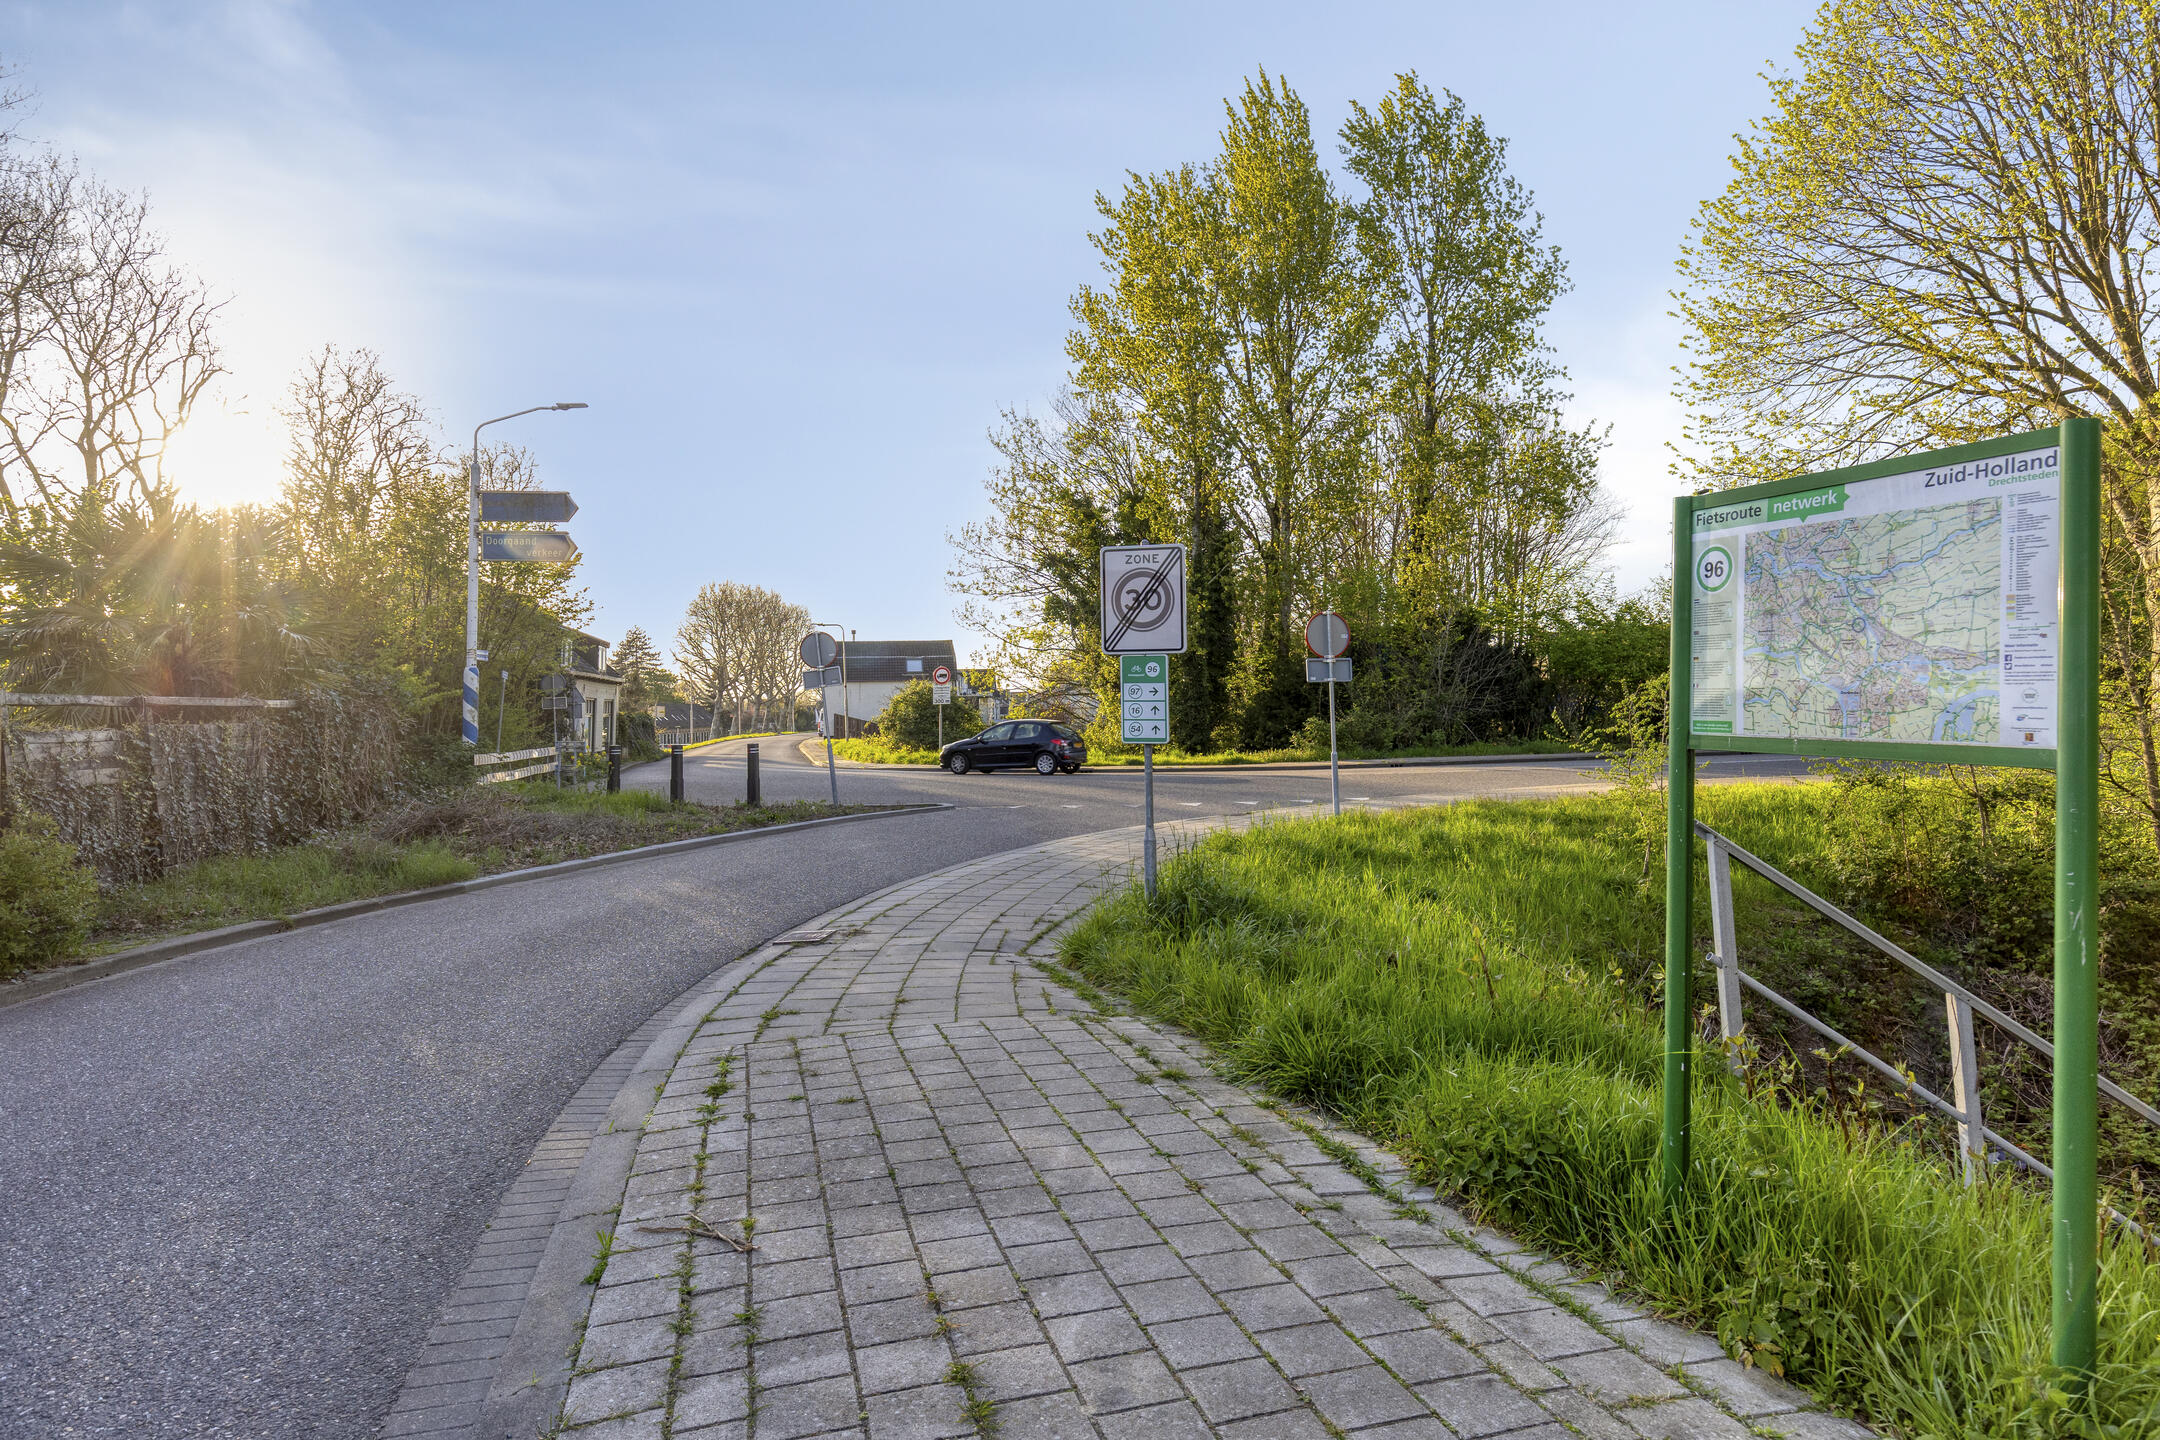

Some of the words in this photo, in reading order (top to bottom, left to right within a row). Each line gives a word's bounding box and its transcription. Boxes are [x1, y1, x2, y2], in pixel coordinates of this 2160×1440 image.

[1924, 449, 2058, 488] Zuid-Holland
[1988, 469, 2059, 487] Drechtsteden
[1696, 505, 1762, 526] Fietsroute
[1773, 490, 1838, 513] netwerk
[486, 536, 537, 548] Doorgaand
[526, 548, 562, 557] verkeer
[1125, 553, 1160, 564] ZONE
[1704, 560, 1724, 578] 96
[1125, 589, 1162, 611] 30
[1147, 665, 1158, 673] 96
[1130, 687, 1140, 695] 97
[1131, 707, 1141, 715] 16
[1130, 725, 1141, 733] 54
